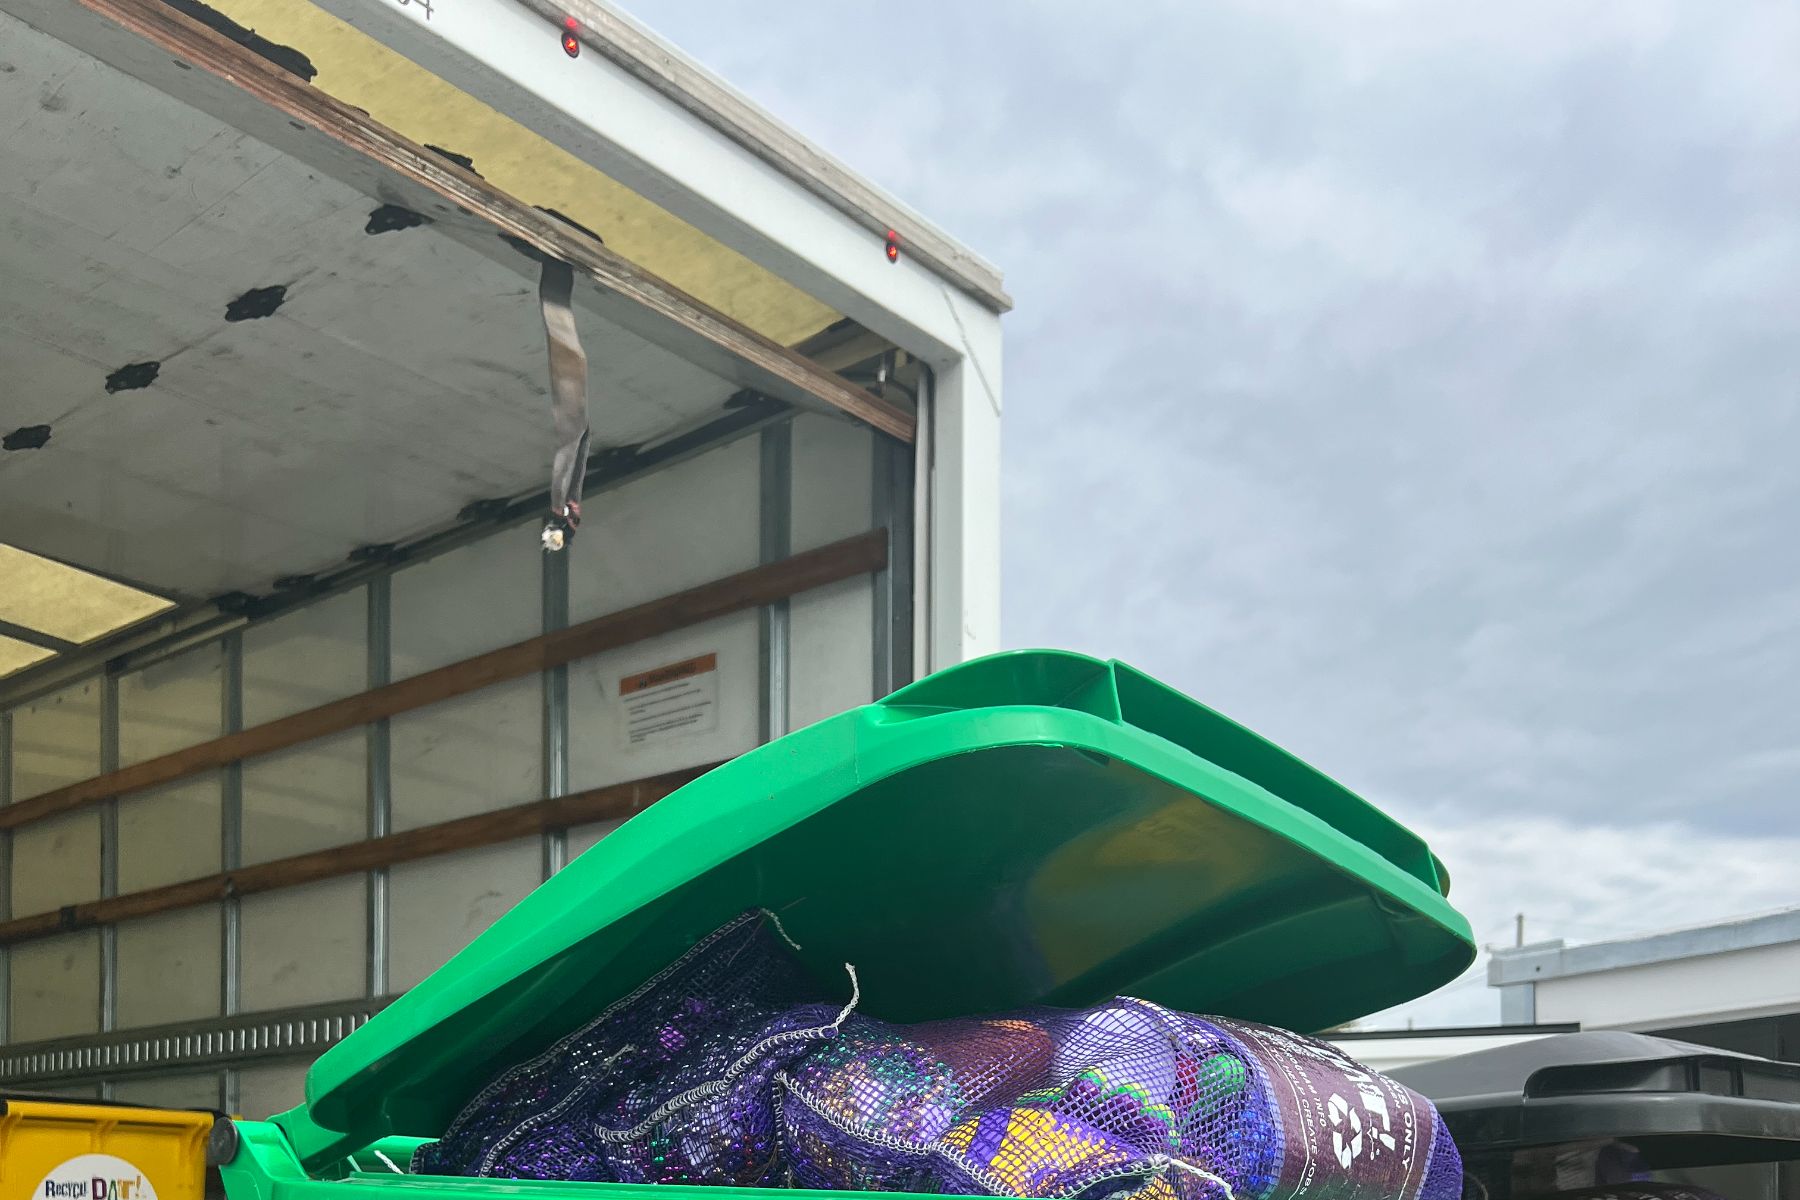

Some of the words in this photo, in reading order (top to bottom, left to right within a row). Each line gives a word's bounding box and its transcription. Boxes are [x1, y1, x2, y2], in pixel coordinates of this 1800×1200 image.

[1284, 1065, 1305, 1096] HELP
[1302, 1099, 1318, 1155] CREATE
[1314, 1097, 1327, 1127] INFO
[1401, 1111, 1413, 1171] ONLY
[1299, 1158, 1317, 1196] JOBS
